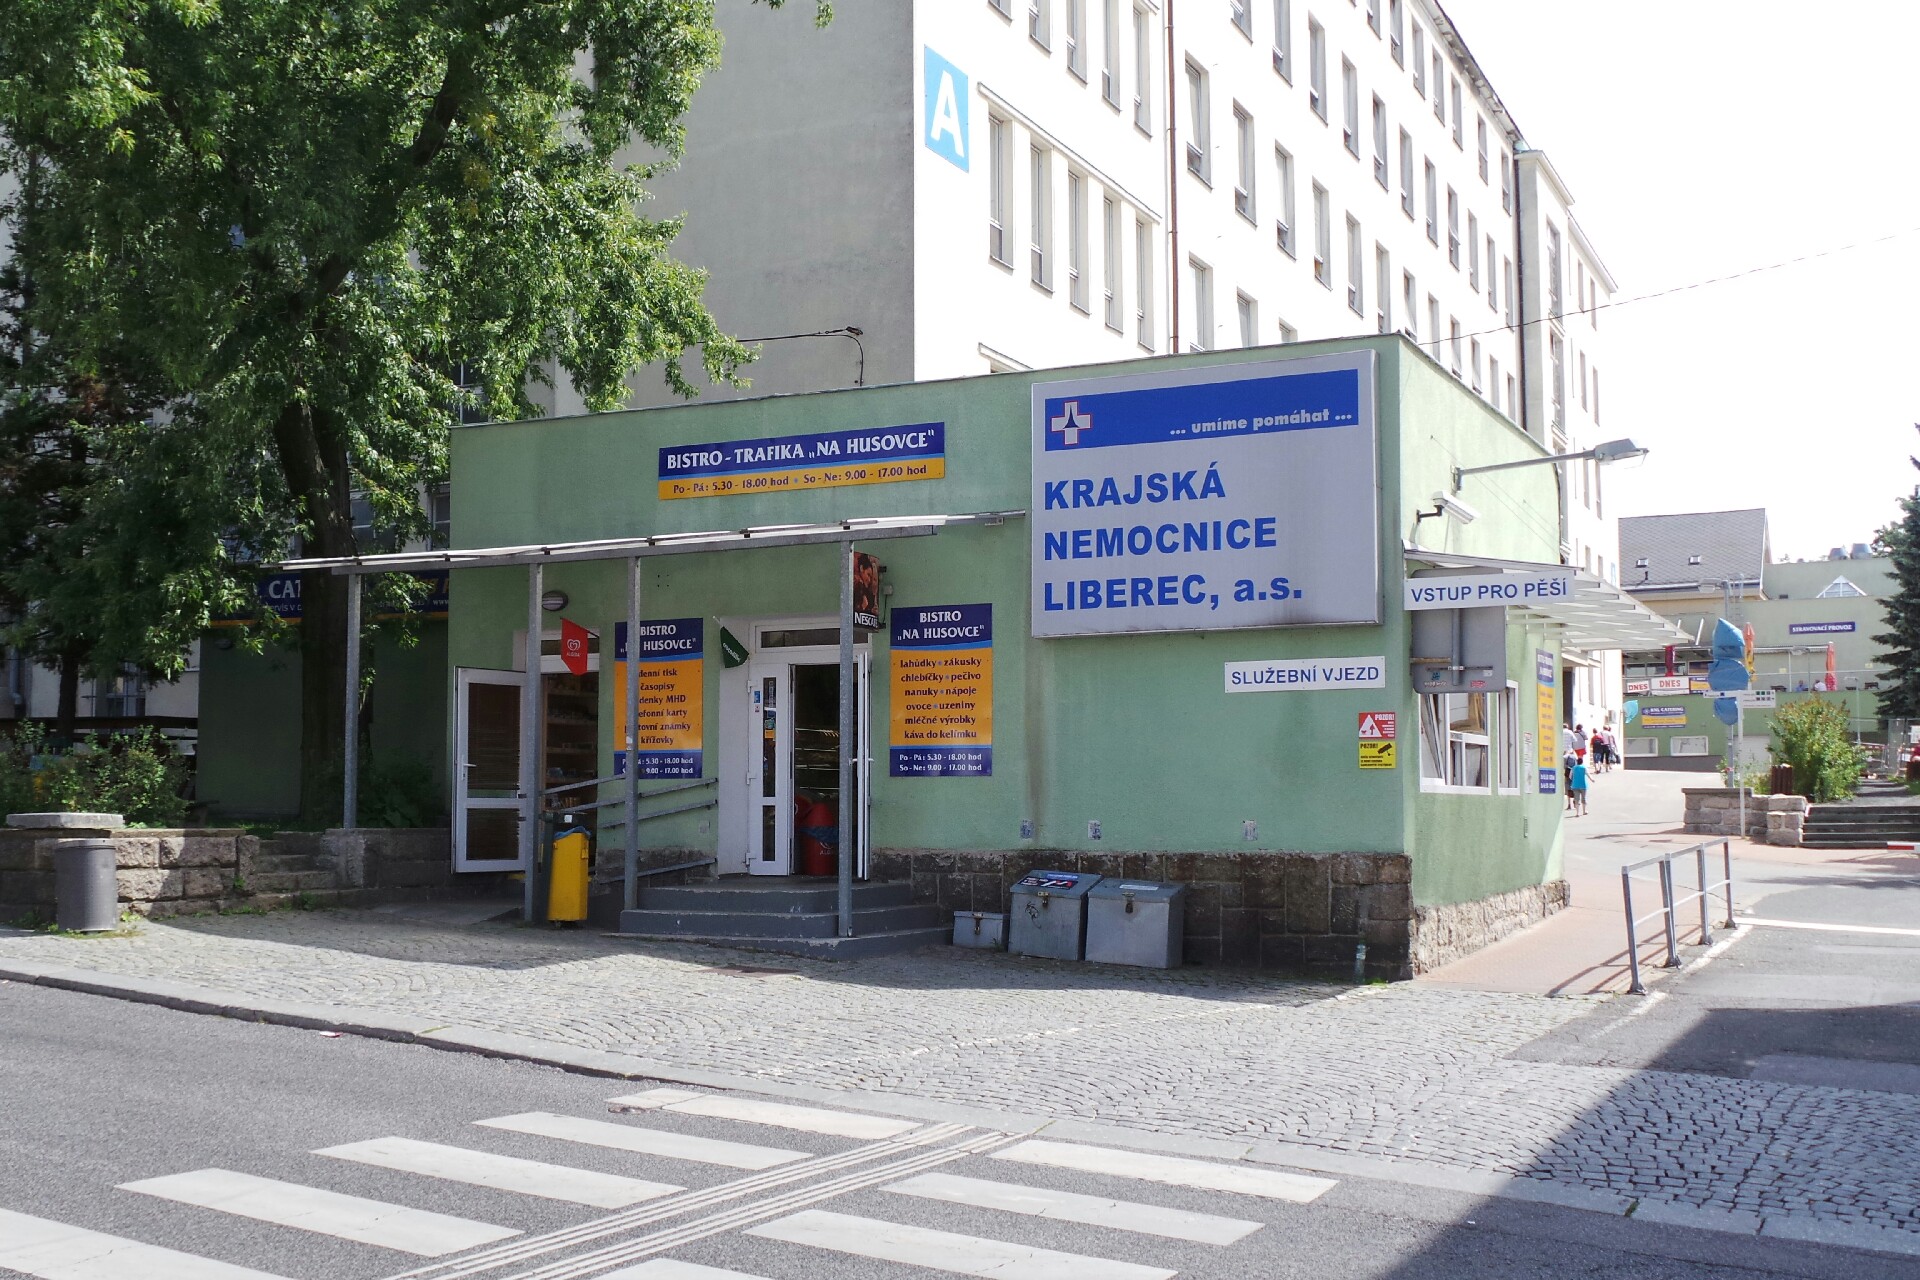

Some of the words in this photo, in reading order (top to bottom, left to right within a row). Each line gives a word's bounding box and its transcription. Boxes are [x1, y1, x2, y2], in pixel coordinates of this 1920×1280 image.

[930, 69, 965, 158] A
[1191, 417, 1248, 434] umíme
[1253, 409, 1330, 431] pomáhat
[667, 450, 723, 469] BISTRO
[734, 443, 804, 464] TRAFIKA
[673, 485, 684, 494] Po
[712, 480, 732, 491] 5.30
[742, 478, 767, 489] 18.00
[770, 476, 789, 486] hod
[803, 474, 816, 483] So
[845, 470, 866, 480] 9.00
[878, 467, 903, 477] 17.00
[907, 465, 927, 475] hod
[1044, 461, 1226, 511] KRAJSKÁ
[1044, 517, 1277, 561] NEMOCNICE
[1044, 574, 1219, 611] LIBEREC,
[1233, 576, 1302, 603] a.s.
[1411, 586, 1471, 602] VSTUP
[1478, 584, 1517, 599] PRO
[1524, 578, 1567, 597] PĚŠÍ
[920, 611, 961, 623] BISTRO
[640, 624, 676, 636] BISTRO
[900, 658, 936, 669] lahůdky
[944, 657, 982, 667] zákusky
[663, 668, 678, 676] tisk
[901, 672, 944, 683] chlebíčky
[951, 672, 981, 682] pečivo
[1231, 665, 1317, 685] SLUŽEBNÍ
[1322, 667, 1379, 681] VJEZD
[640, 683, 675, 692] časopisy
[905, 688, 938, 697] nanuky
[946, 685, 976, 696] nápoje
[639, 696, 664, 705] denky
[666, 695, 686, 703] MHD
[939, 700, 976, 710] uzeniny
[638, 708, 664, 717] efonní
[666, 709, 688, 718] karty
[904, 715, 938, 724] mléčné
[940, 715, 976, 725] výrobky
[904, 730, 924, 738] káva
[926, 730, 938, 738] do
[940, 730, 977, 738] kelímku
[641, 736, 674, 745] křížovky
